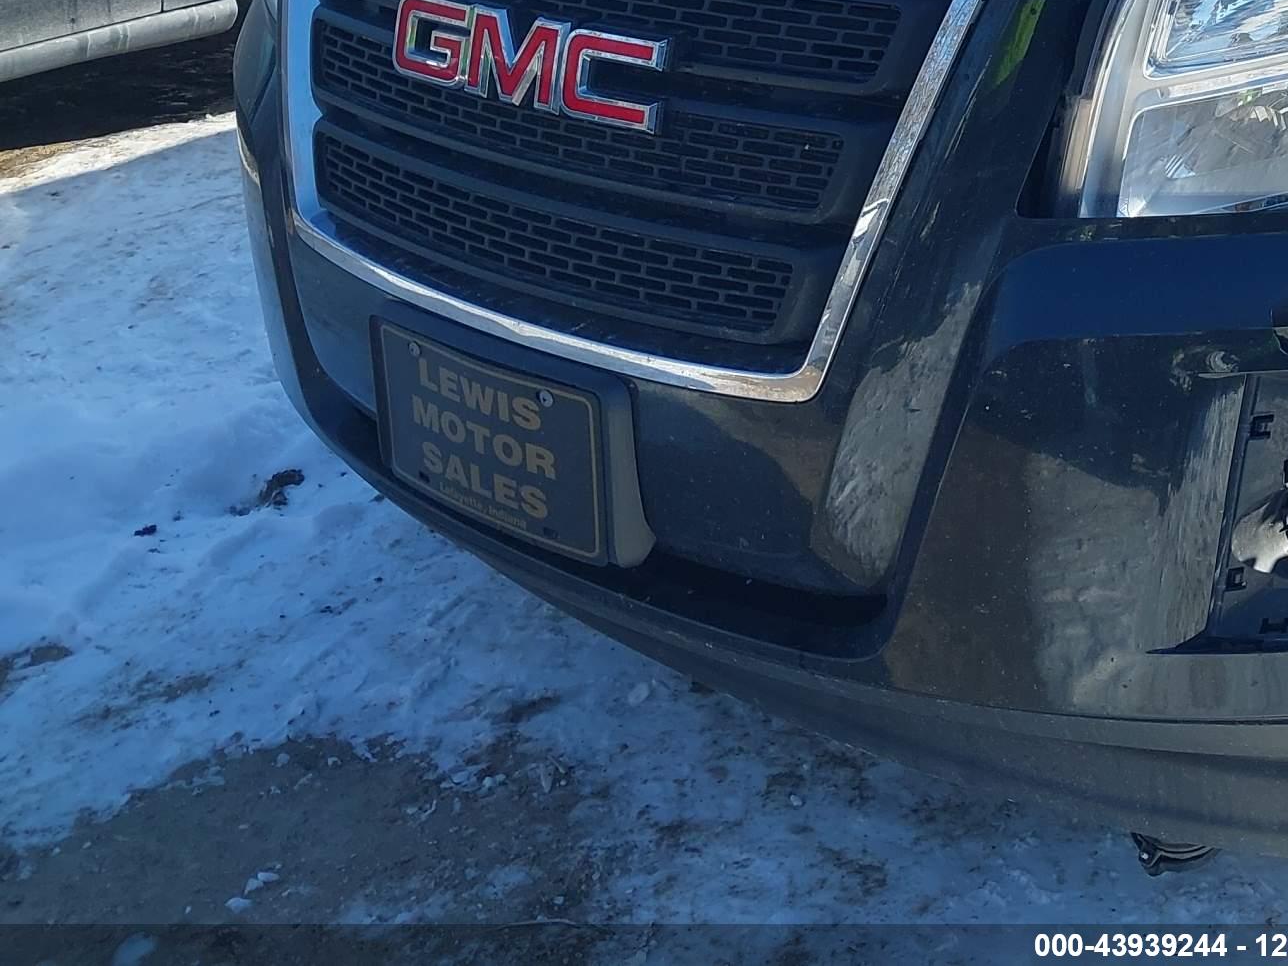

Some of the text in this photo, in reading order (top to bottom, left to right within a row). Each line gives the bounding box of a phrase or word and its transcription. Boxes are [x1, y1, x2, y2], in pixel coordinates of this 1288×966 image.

[418, 357, 543, 432] LEWIS
[412, 394, 557, 481] MOTOR
[421, 441, 549, 520] SALES
